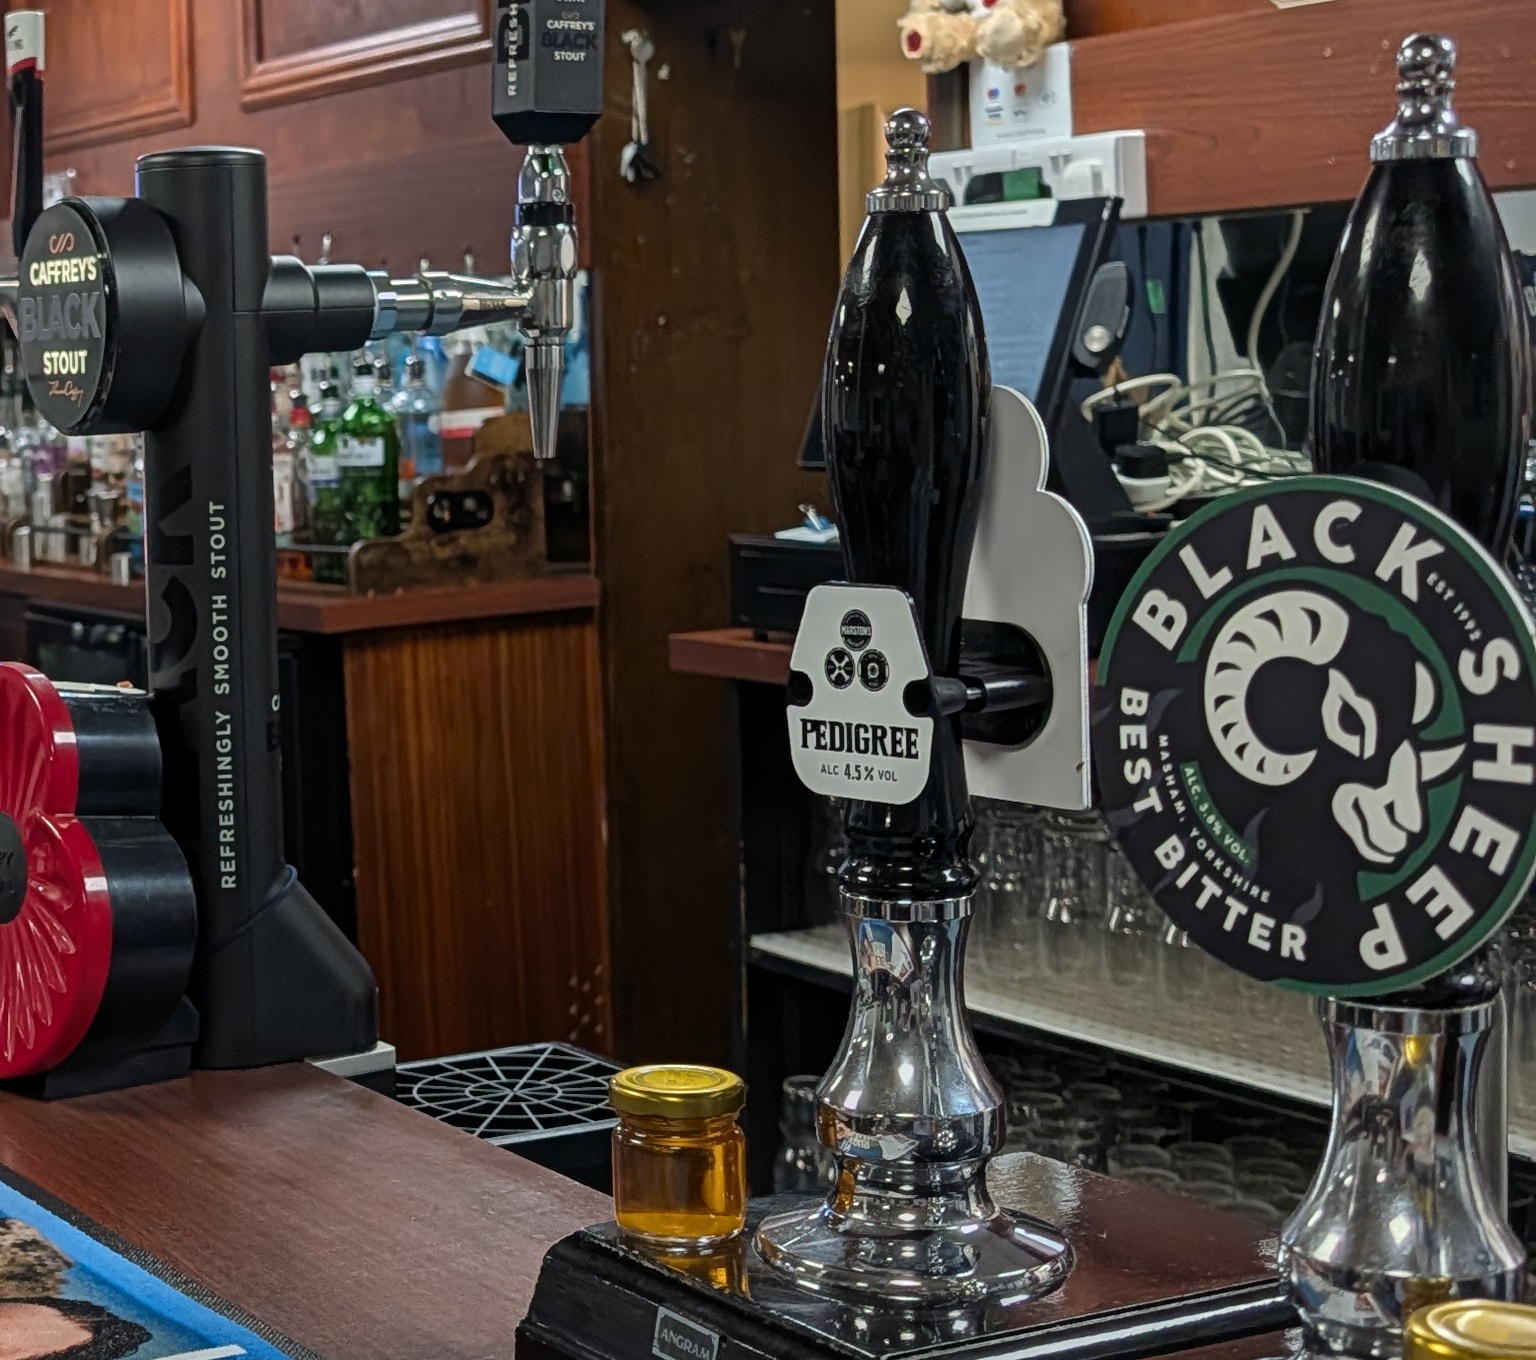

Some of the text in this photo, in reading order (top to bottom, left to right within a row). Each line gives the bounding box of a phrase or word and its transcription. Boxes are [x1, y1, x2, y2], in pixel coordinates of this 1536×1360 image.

[541, 31, 598, 50] BLACK
[554, 51, 586, 62] STOUT
[19, 291, 102, 342] BLACK
[42, 349, 88, 376] STOUT
[1426, 571, 1455, 601] EST
[208, 500, 237, 889] REFRESHINGLY SMOOTH STOUT
[799, 718, 919, 760] PEDIGREE
[1132, 499, 1535, 971] BLACK SHEEP
[820, 763, 898, 782] ALC 4.5% VOL
[1119, 686, 1309, 963] BEST BITTER
[1189, 827, 1271, 904] YORKSHIRE
